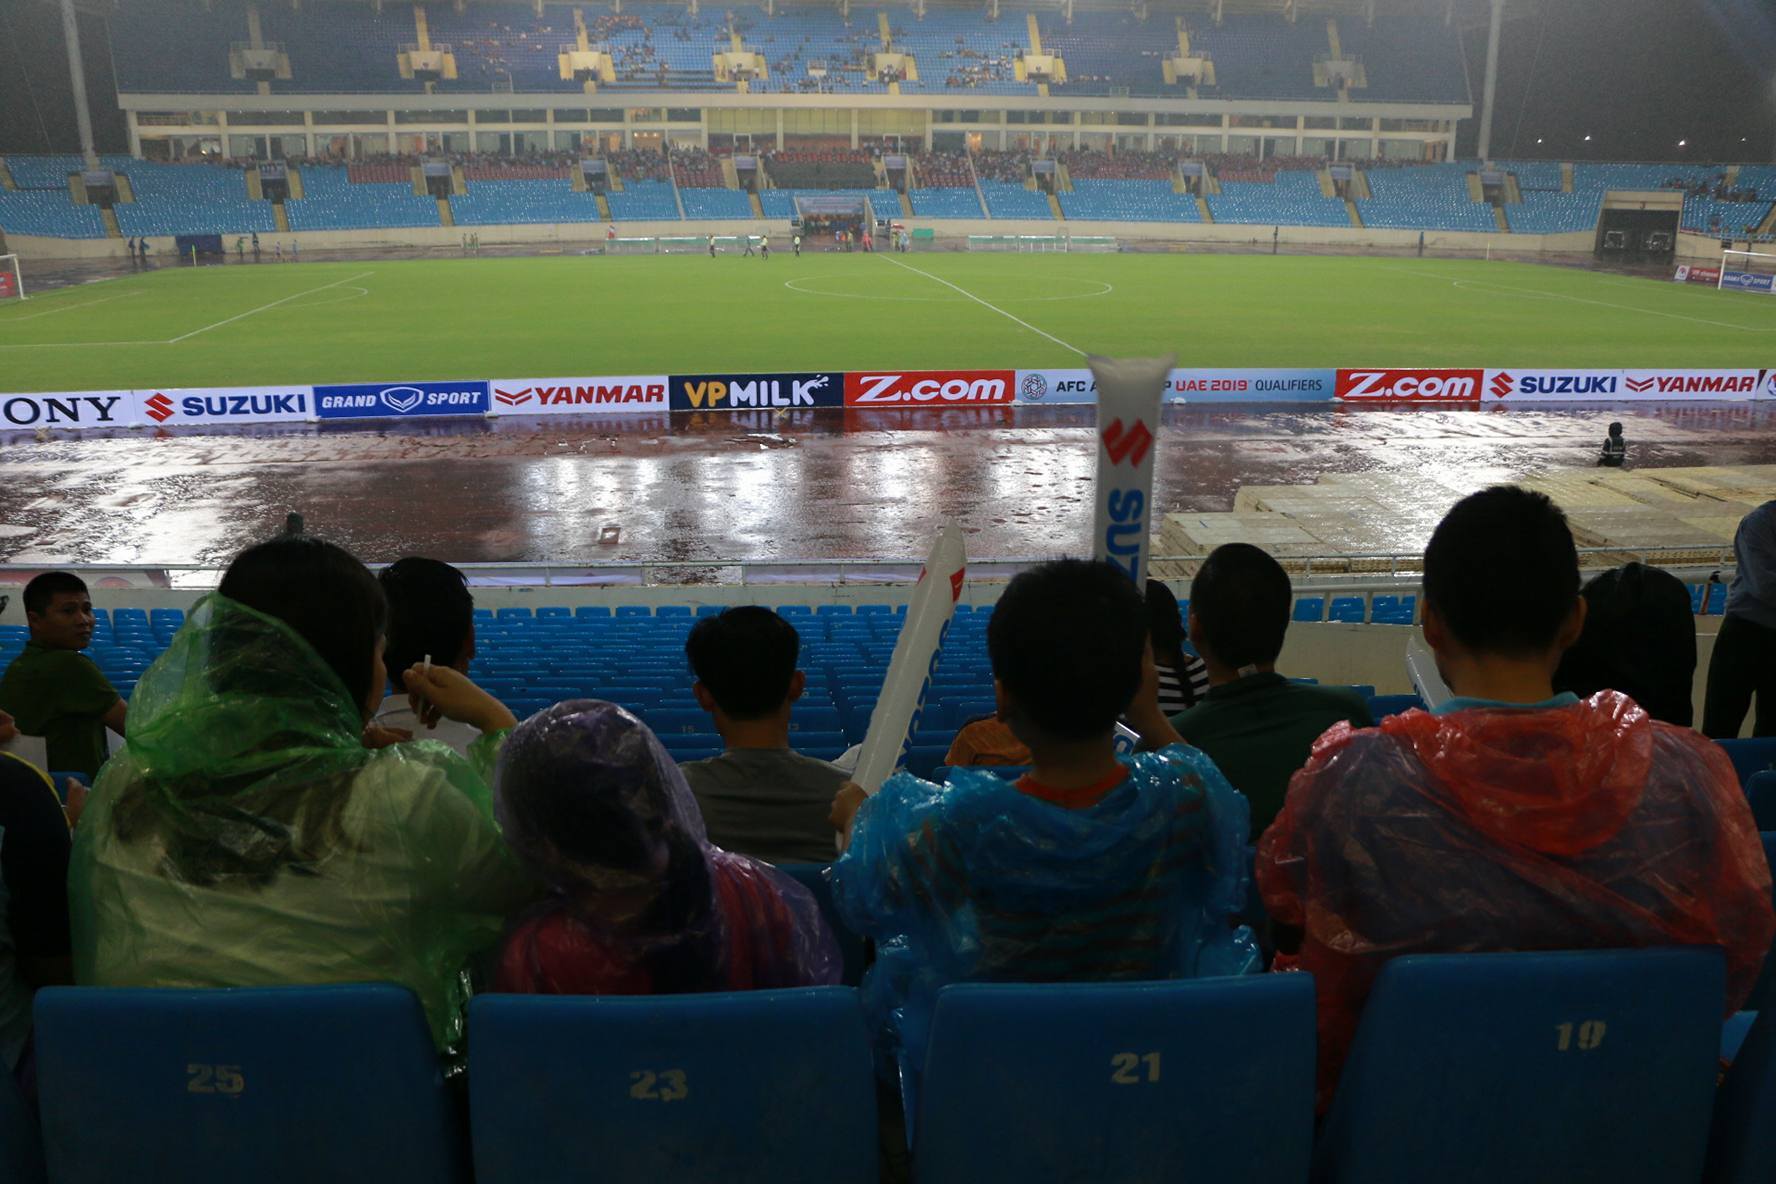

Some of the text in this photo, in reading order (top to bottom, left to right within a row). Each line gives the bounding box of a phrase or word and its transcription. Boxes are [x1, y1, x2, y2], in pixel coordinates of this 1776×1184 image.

[535, 384, 665, 405] YANMAR
[1056, 381, 1086, 392] AFC
[1175, 380, 1207, 391] UAE
[1211, 380, 1248, 391] 2019
[1255, 379, 1322, 391] QUALIFIERS
[1519, 376, 1617, 394] SUZUKI
[1657, 376, 1755, 392] YANMAR
[182, 394, 306, 416] SUZUKI
[322, 391, 481, 409] GRAND SPORT
[1555, 1020, 1606, 1051] 19
[1110, 1052, 1161, 1084] 21
[186, 1064, 245, 1094] 25
[629, 1068, 689, 1101] 23
